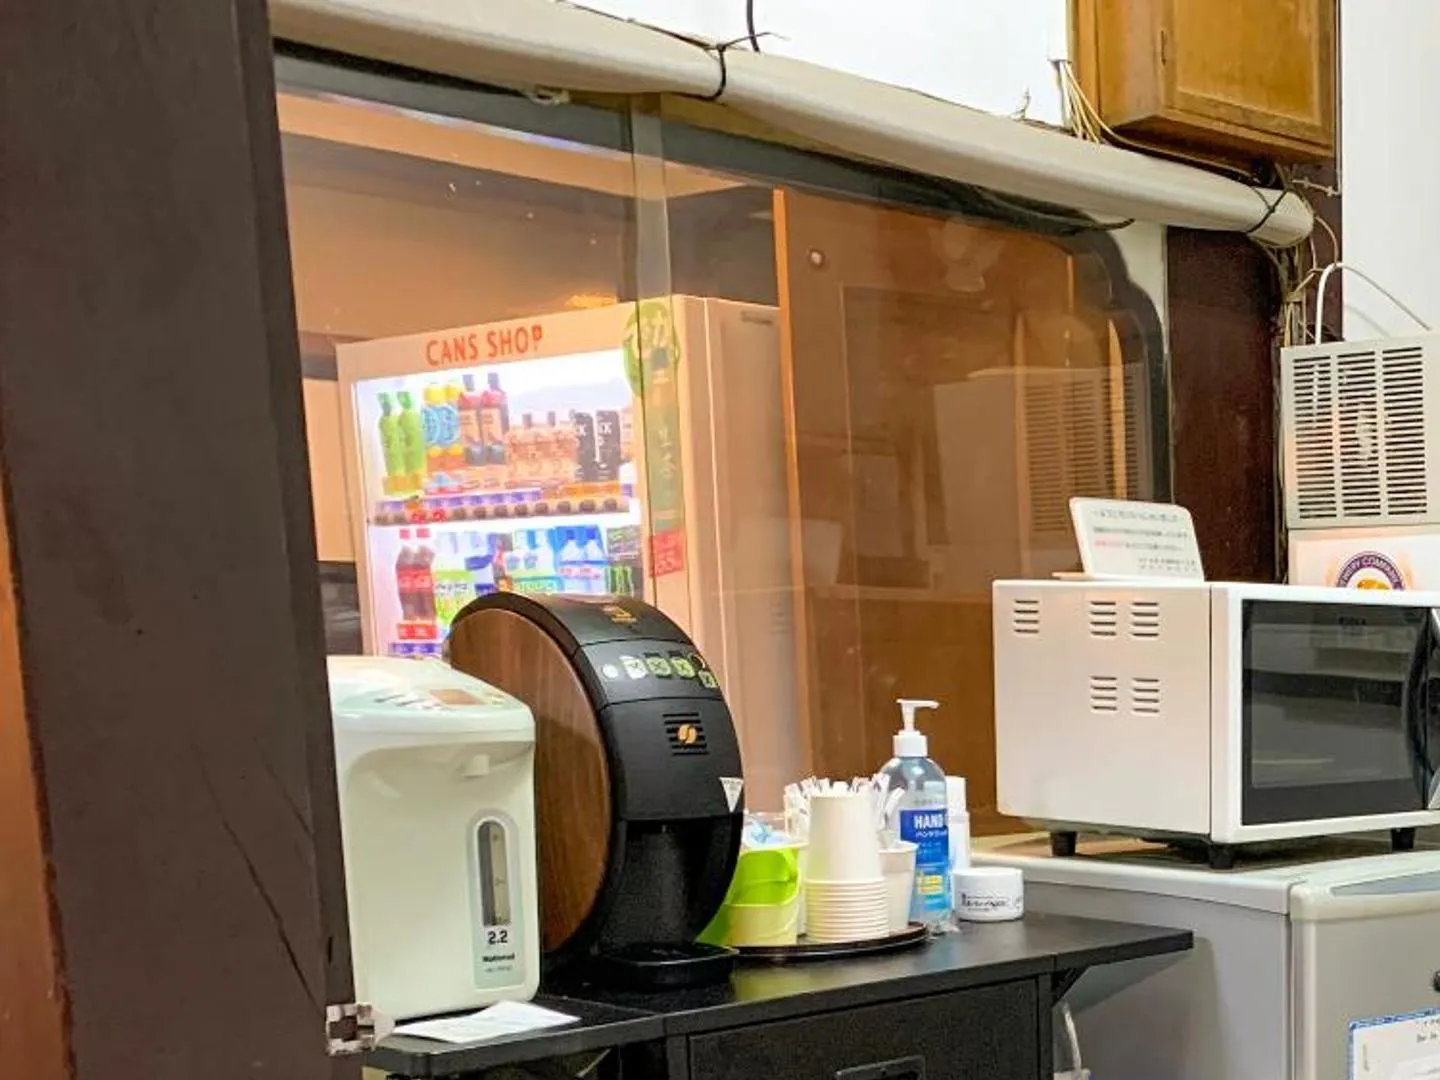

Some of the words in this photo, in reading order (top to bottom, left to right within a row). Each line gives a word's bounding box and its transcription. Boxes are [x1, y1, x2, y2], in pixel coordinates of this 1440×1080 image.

[426, 333, 479, 367] CANS
[486, 324, 543, 358] SHOP
[488, 930, 508, 945] 2.2
